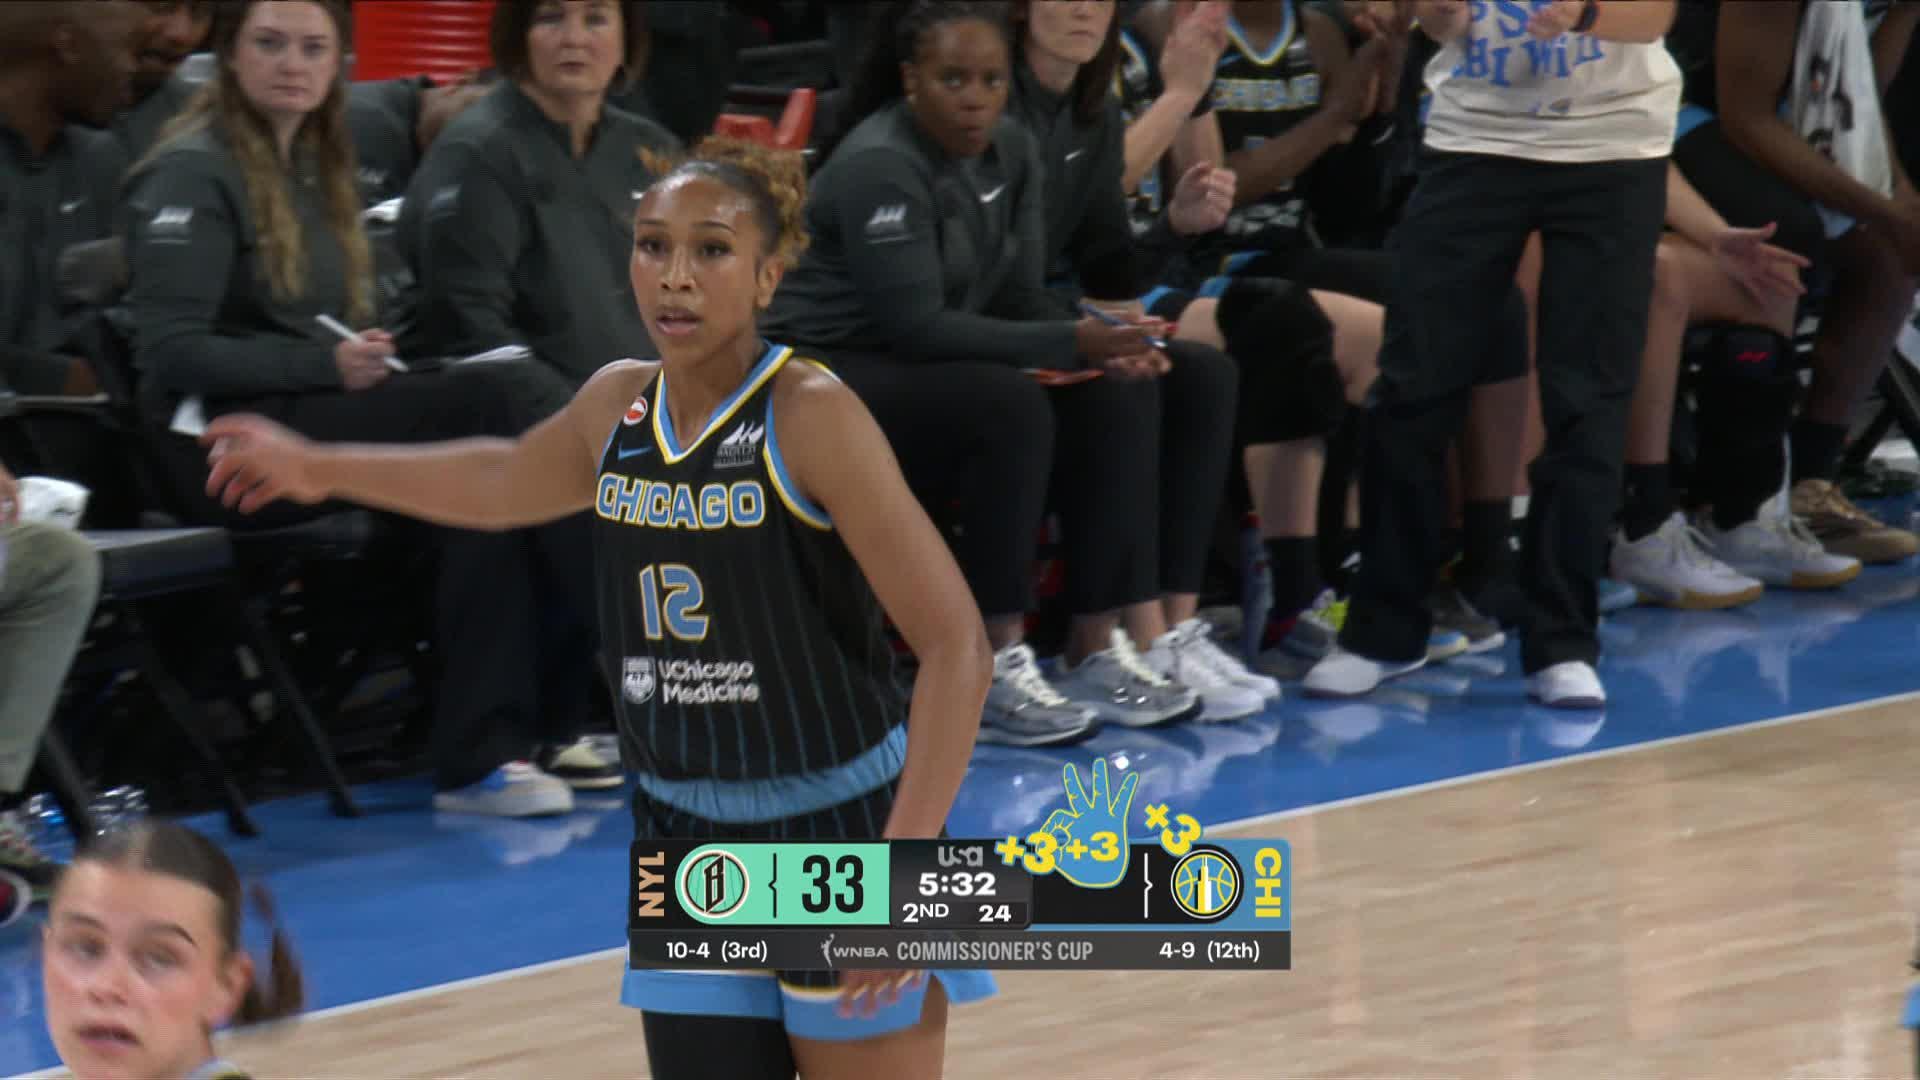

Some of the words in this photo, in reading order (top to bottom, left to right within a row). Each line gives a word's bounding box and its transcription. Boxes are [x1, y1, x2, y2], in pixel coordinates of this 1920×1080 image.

[595, 472, 766, 530] CHICAGO
[639, 563, 710, 641] 12
[657, 658, 754, 682] UChicago
[662, 680, 760, 704] Medicine
